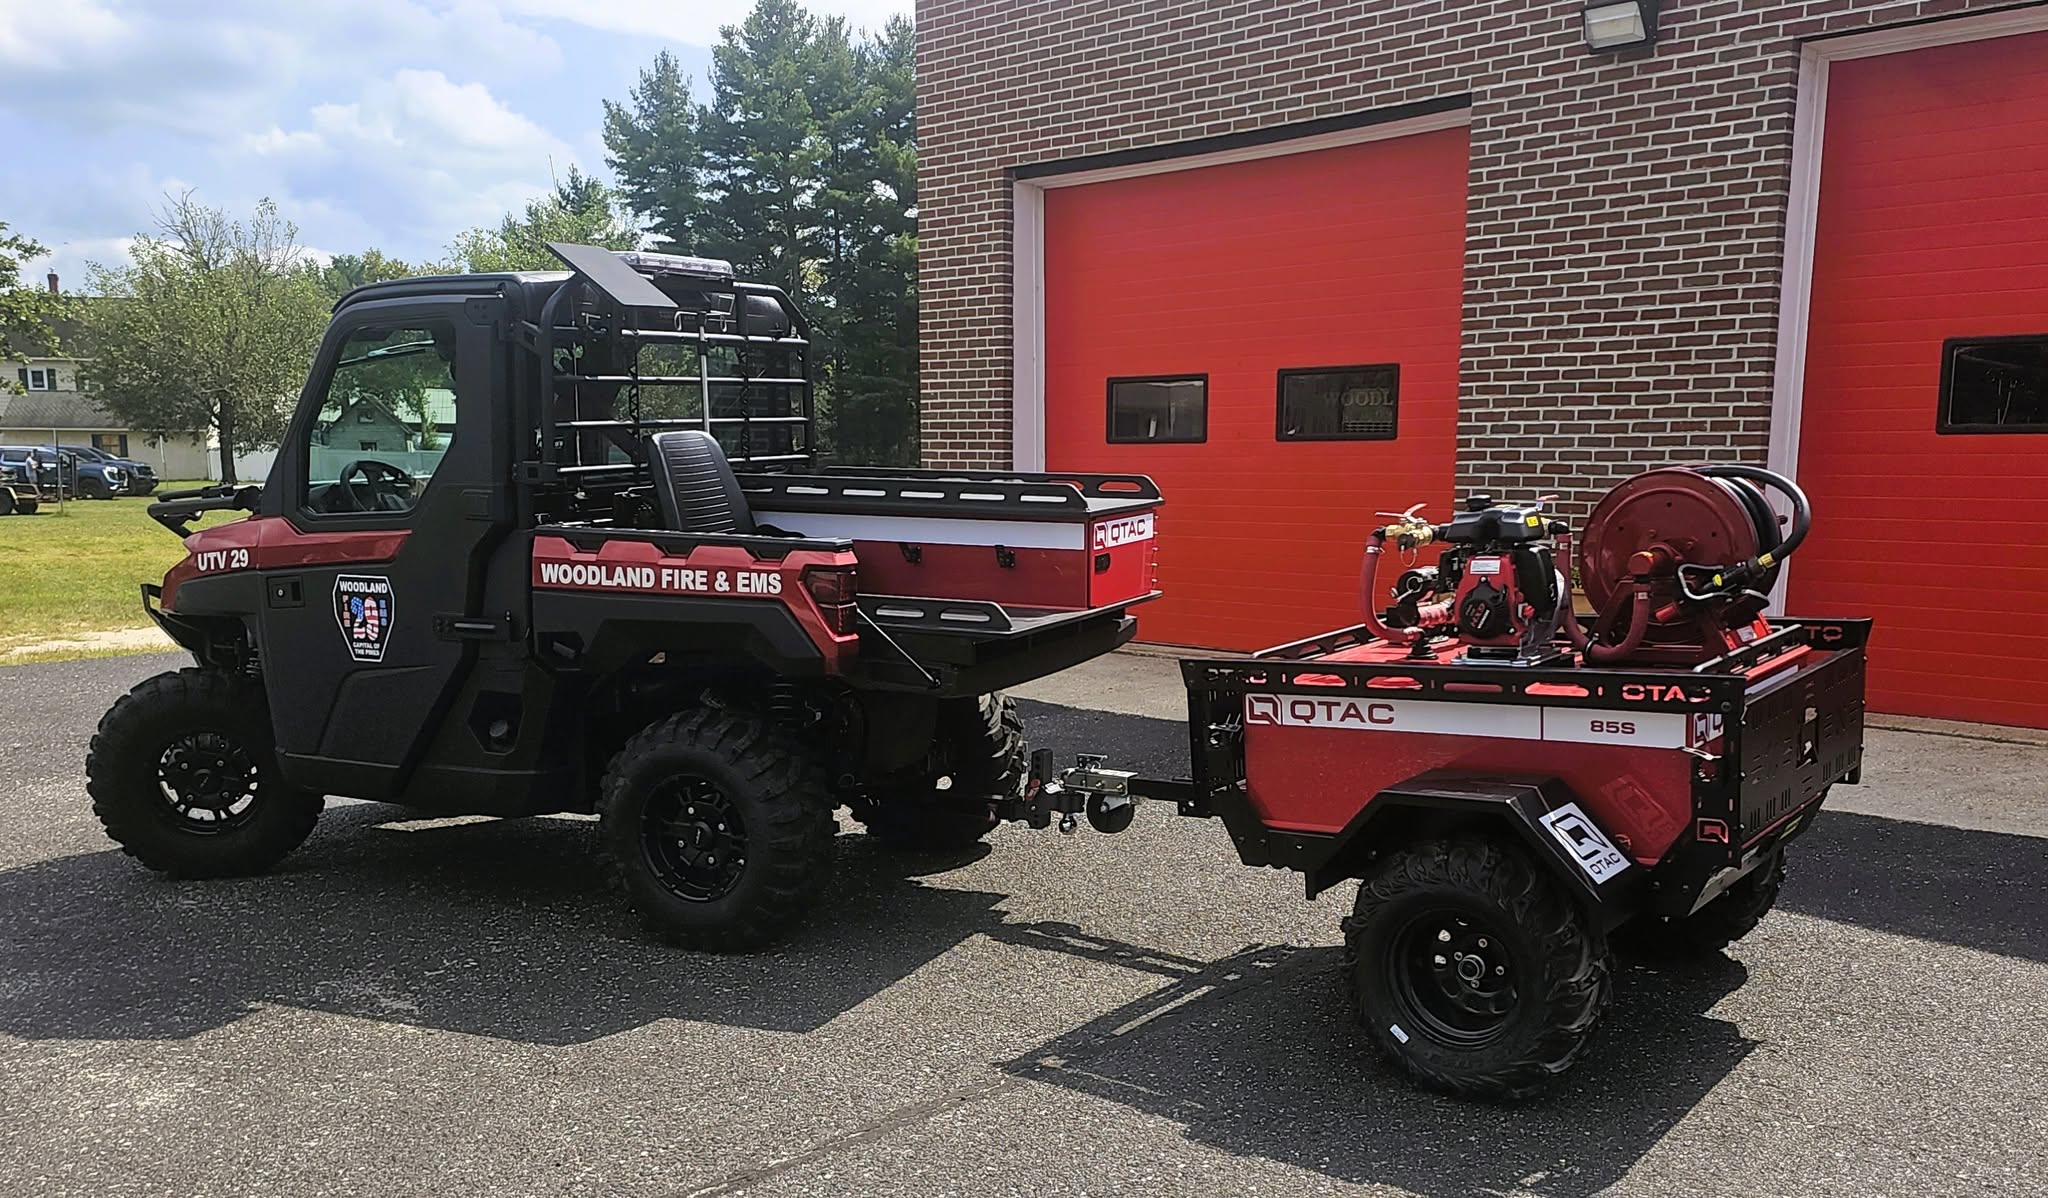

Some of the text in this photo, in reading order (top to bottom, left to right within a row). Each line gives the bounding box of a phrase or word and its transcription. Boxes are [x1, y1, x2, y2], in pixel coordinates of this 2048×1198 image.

[1110, 518, 1146, 544] QTAC
[197, 548, 249, 571] UTV 29
[339, 580, 388, 594] WOODLAND
[541, 563, 782, 594] WOODLAND FIRE & EMS
[352, 641, 373, 649] CAPITAL
[1289, 699, 1395, 724] QTAC
[1590, 720, 1636, 735] 85S
[1589, 852, 1621, 875] QTAC
